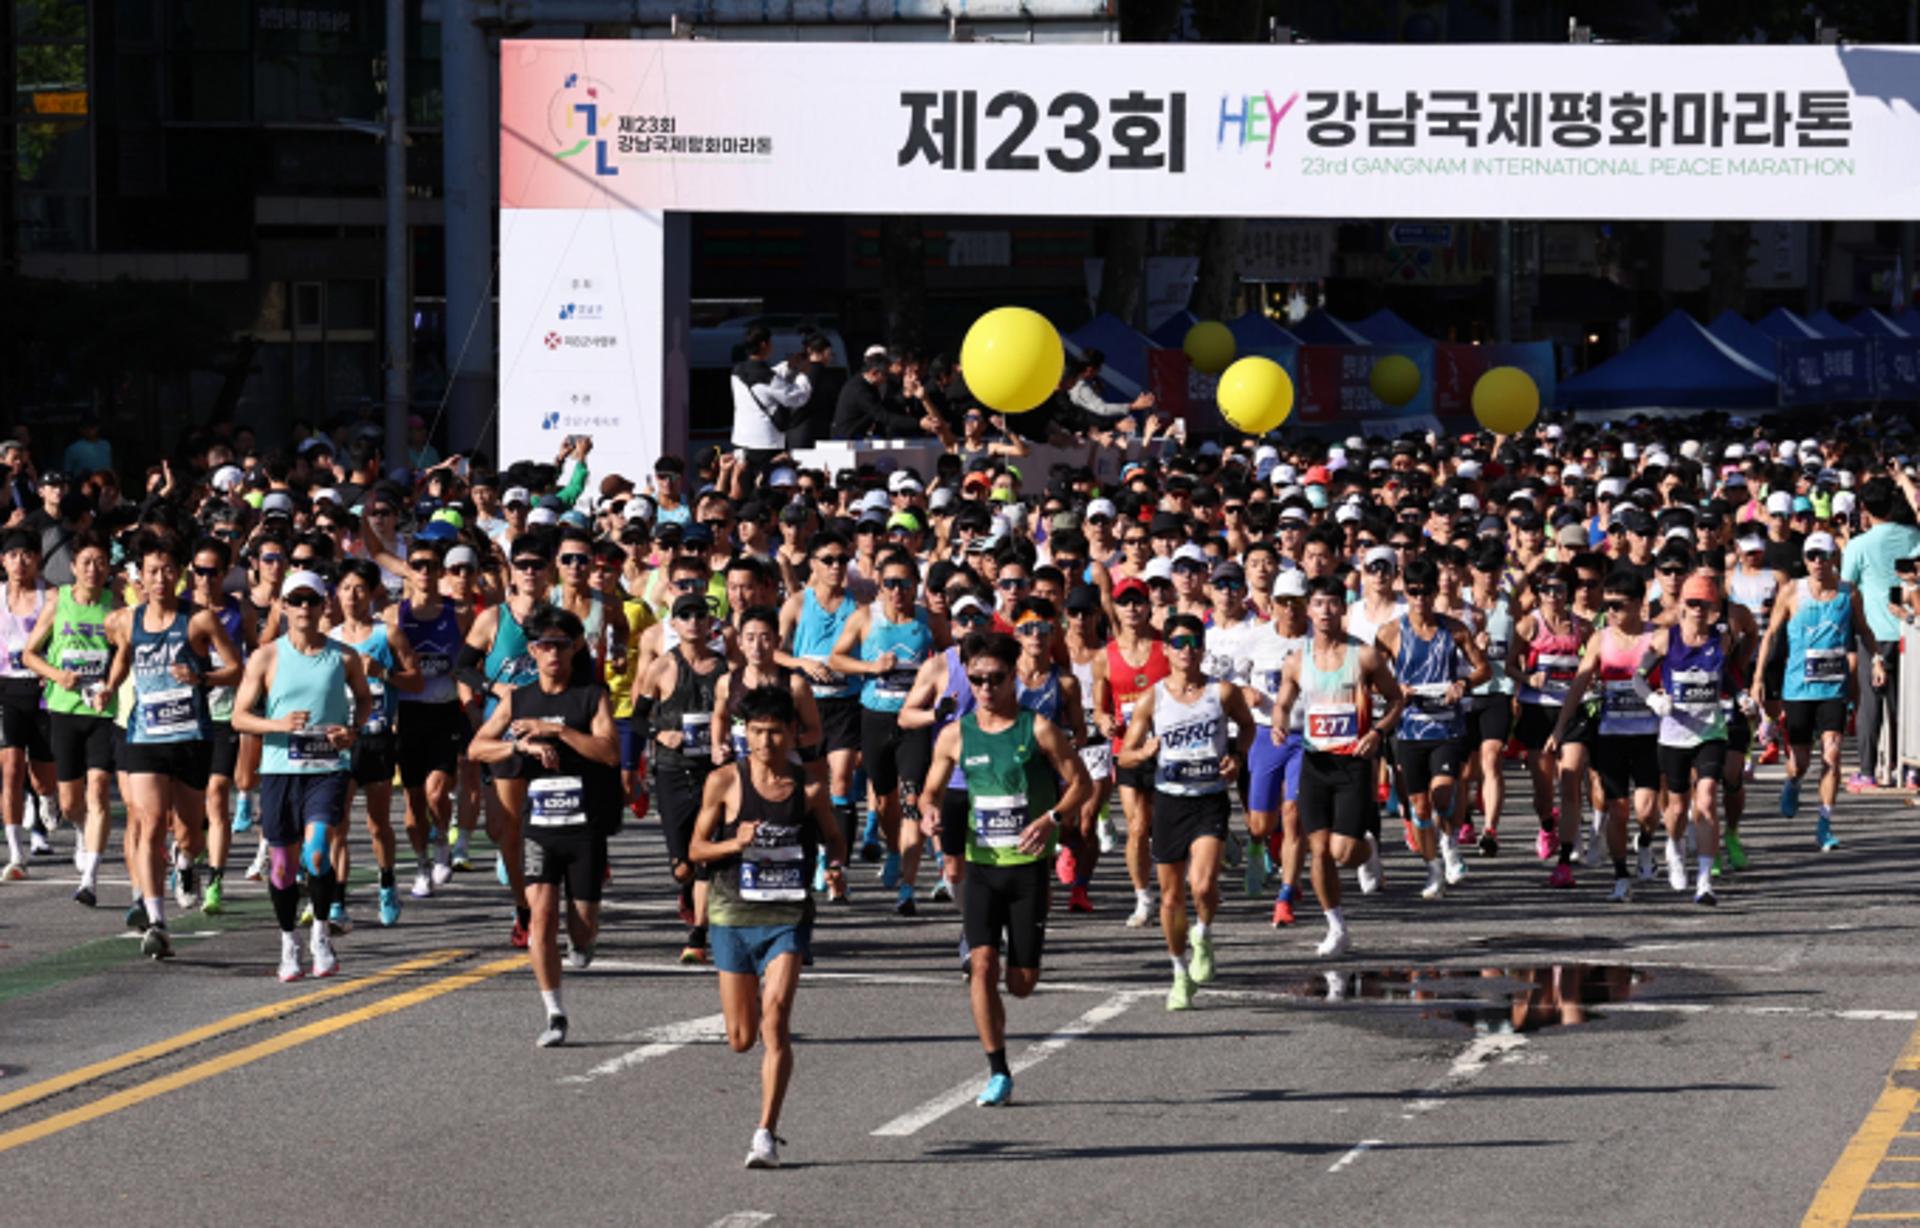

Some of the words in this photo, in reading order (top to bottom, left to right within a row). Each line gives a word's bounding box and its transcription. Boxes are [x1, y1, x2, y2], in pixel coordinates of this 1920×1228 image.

[618, 116, 675, 133] 제23회
[899, 90, 1186, 173] 제23회
[1306, 90, 1852, 149] 강남국제평화마라톤
[618, 135, 772, 154] 강남국제평화마라톤
[1301, 157, 1347, 175] 23rd
[1352, 157, 1467, 175] GANGNAM
[1473, 157, 1644, 176] INTERNATIONAL
[1650, 157, 1723, 176] PEACE
[1727, 157, 1855, 176] MARATHON
[1315, 716, 1350, 736] 277
